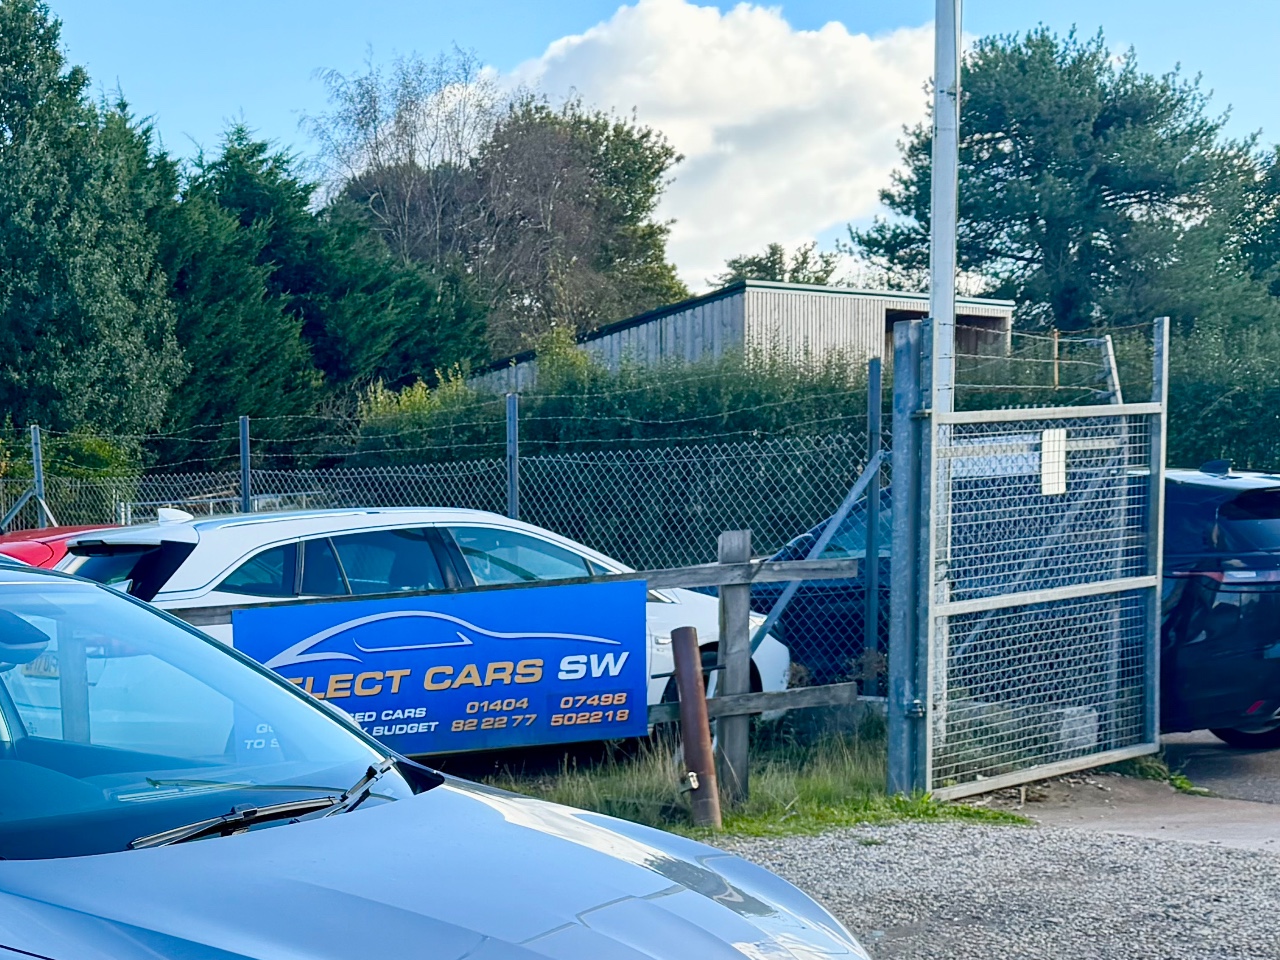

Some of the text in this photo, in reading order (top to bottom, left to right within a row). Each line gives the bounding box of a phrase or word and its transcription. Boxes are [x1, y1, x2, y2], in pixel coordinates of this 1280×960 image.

[287, 651, 630, 699] LECT CARS SW
[465, 692, 628, 714] 01404 07498
[380, 707, 427, 720] CARS
[451, 709, 630, 732] 82 22 77 502218
[372, 721, 439, 736] BUDGET
[244, 739, 265, 749] TO
